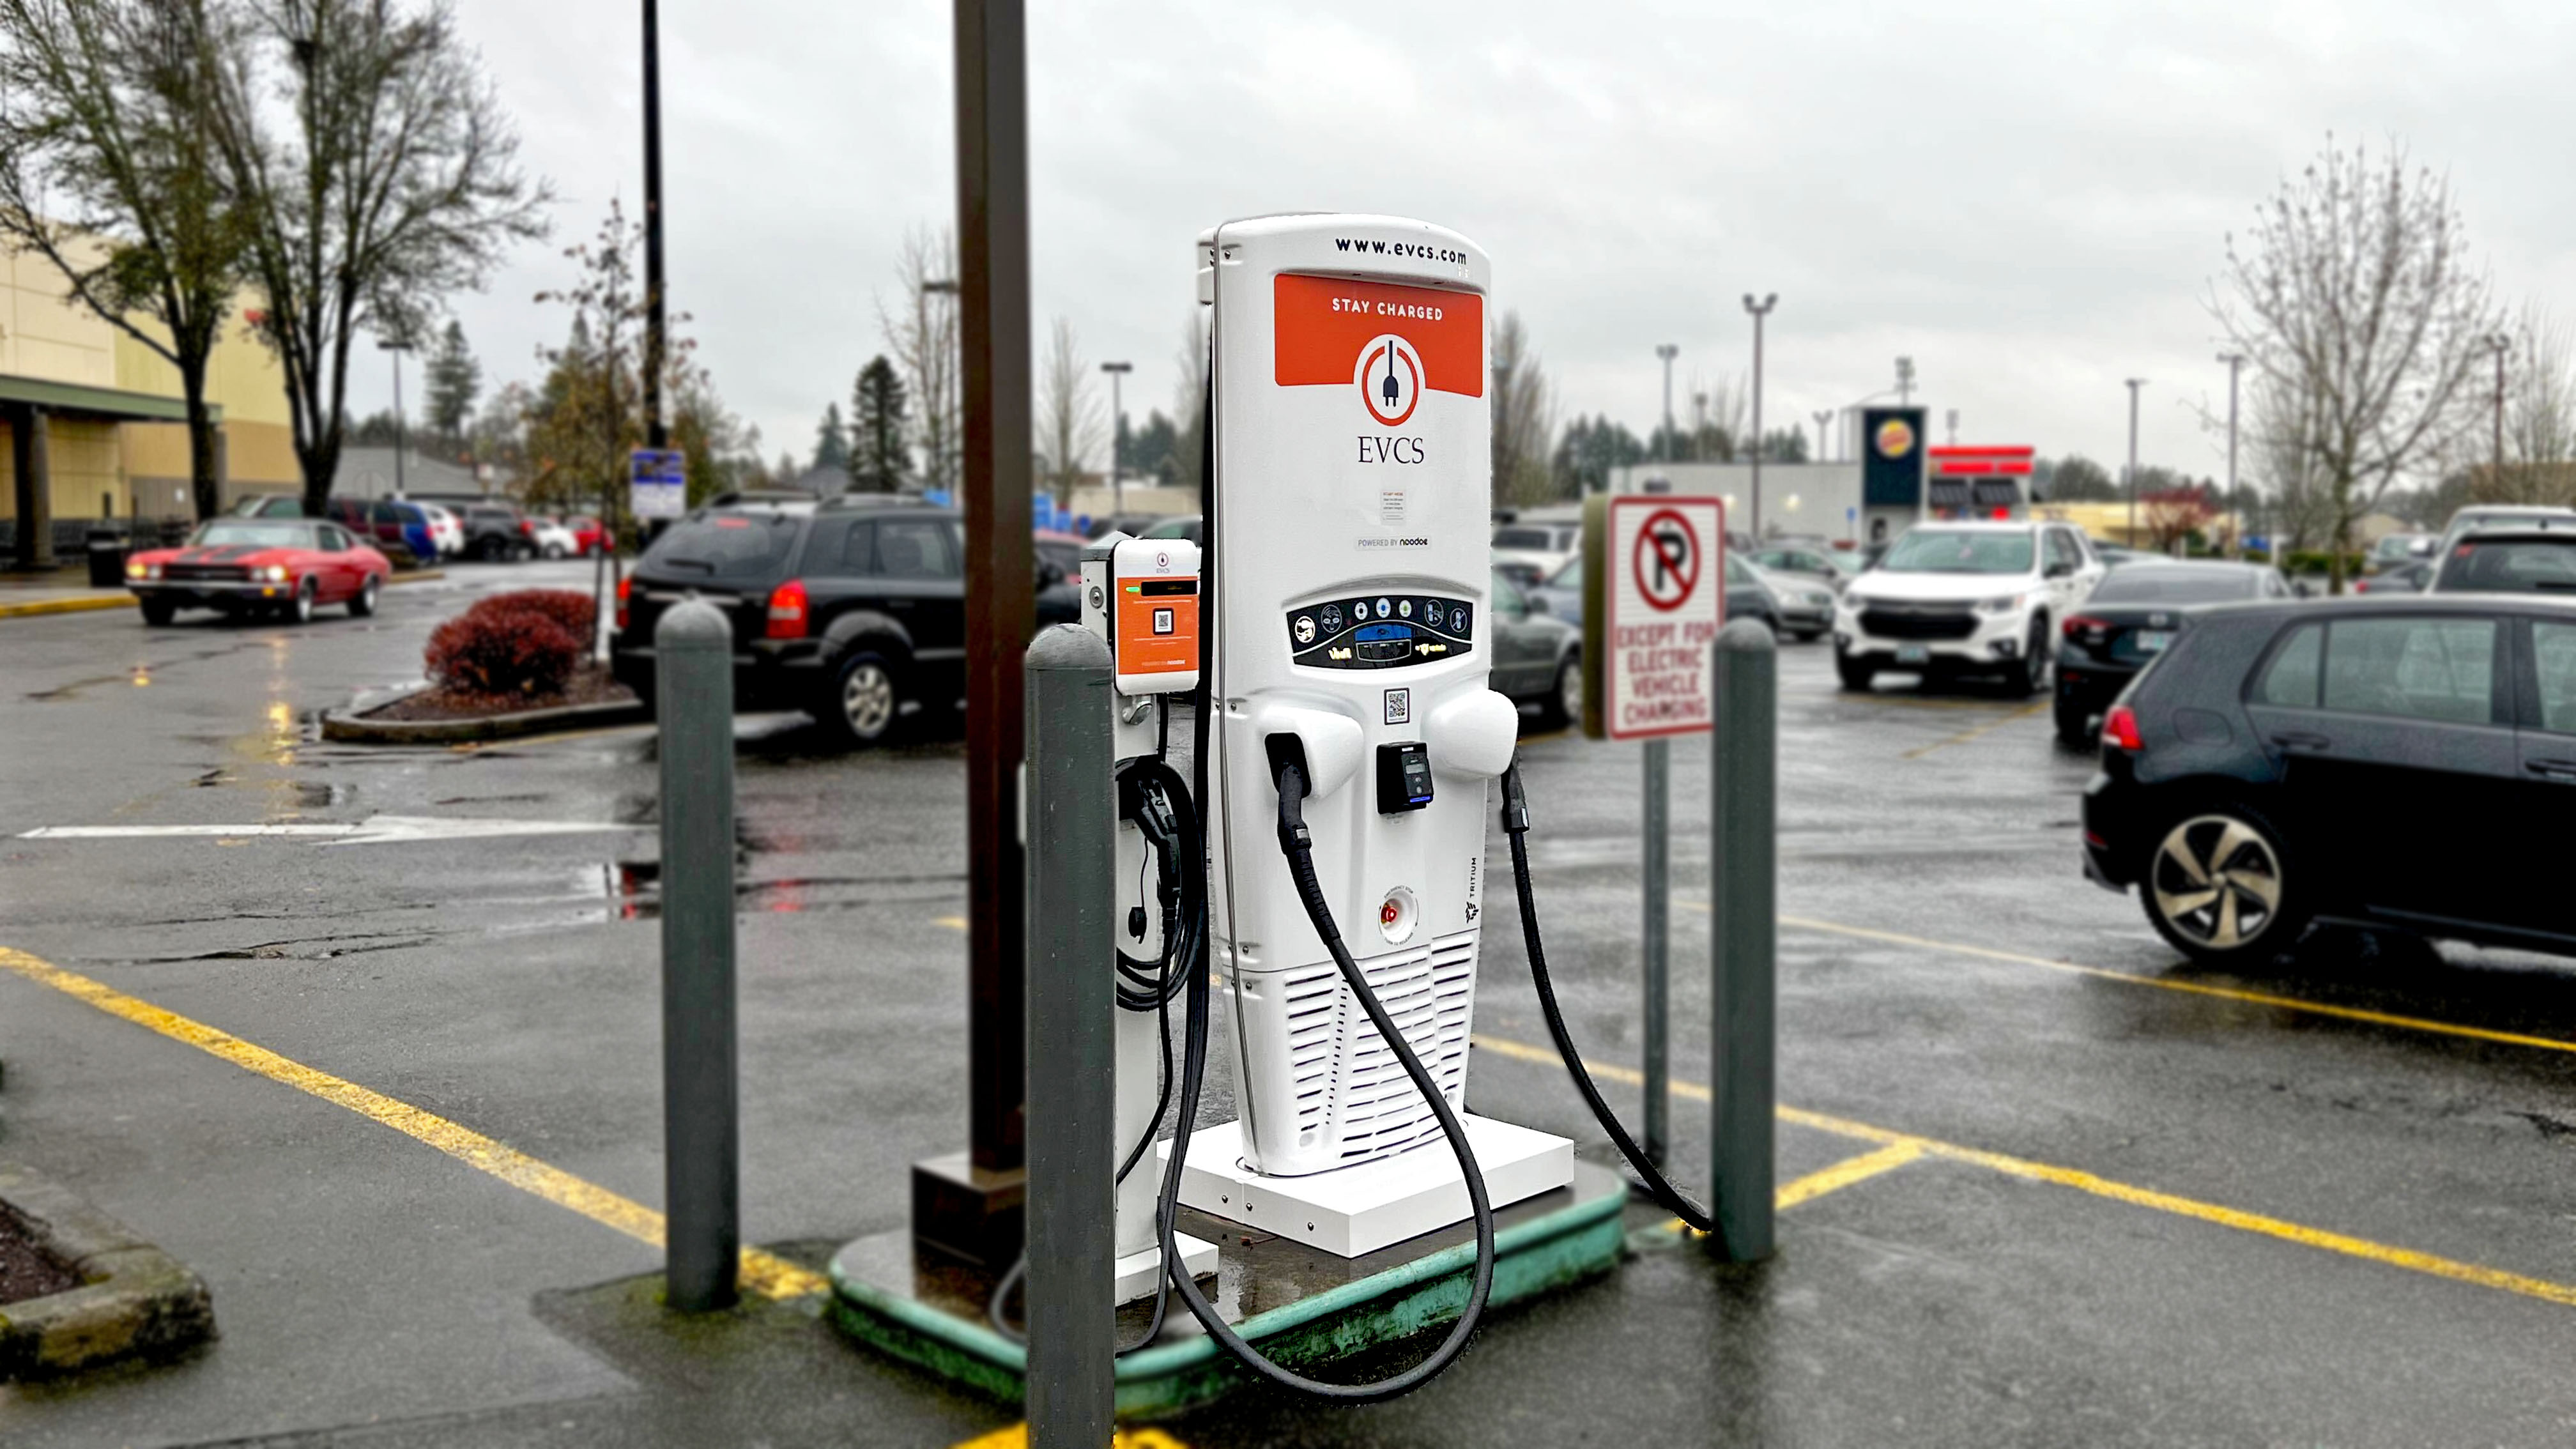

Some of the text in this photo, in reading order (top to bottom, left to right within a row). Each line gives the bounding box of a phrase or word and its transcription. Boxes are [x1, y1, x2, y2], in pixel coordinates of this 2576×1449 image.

[1335, 238, 1467, 265] www.evcs.com
[1332, 298, 1443, 321] STAY CHARGED
[1358, 436, 1425, 464] EVCS
[1358, 539, 1390, 547] POWERED
[1400, 537, 1428, 546] noodoe
[1616, 621, 1715, 648] EXCEPT FOR
[1627, 647, 1703, 674] ELECTRIC
[1632, 671, 1699, 700] VEHICLE
[1623, 695, 1706, 726] CHARGING
